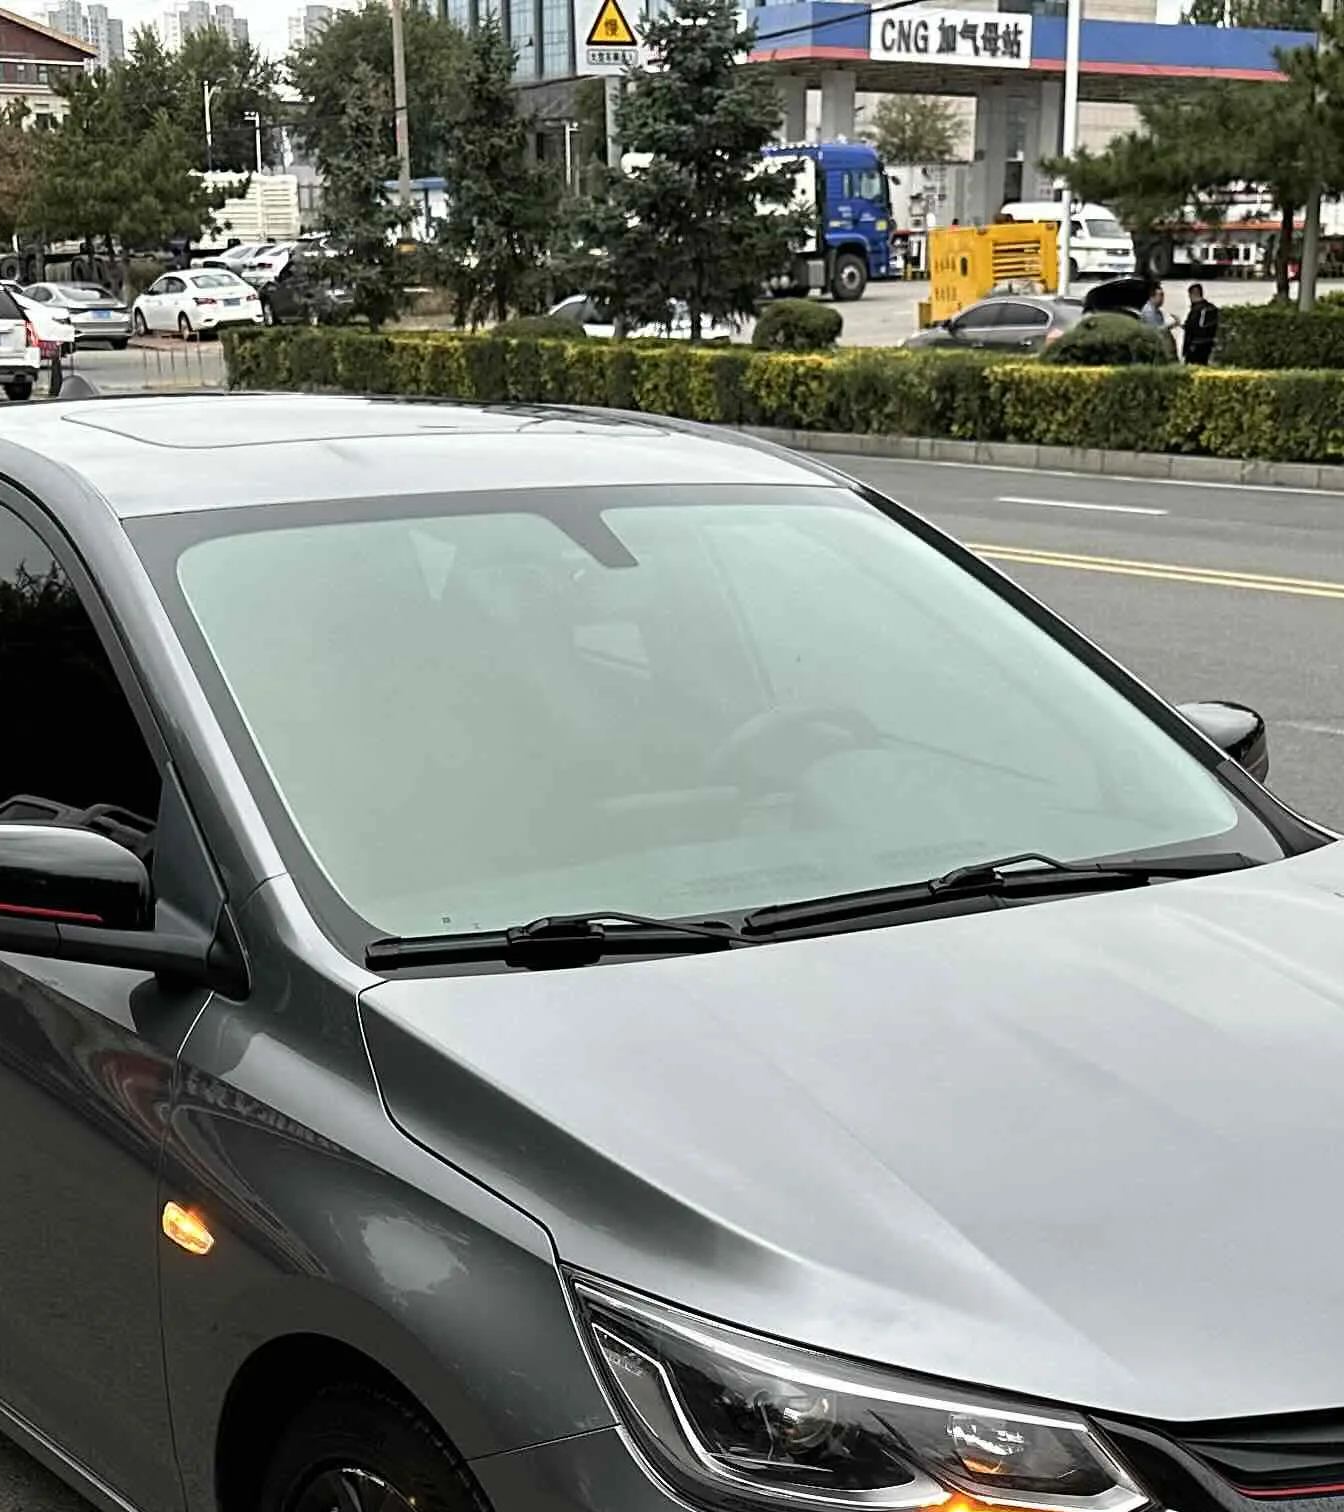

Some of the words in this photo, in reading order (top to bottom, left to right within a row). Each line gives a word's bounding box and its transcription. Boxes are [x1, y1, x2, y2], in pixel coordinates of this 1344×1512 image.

[881, 18, 929, 53] CNG
[936, 17, 1023, 58] 加气母站
